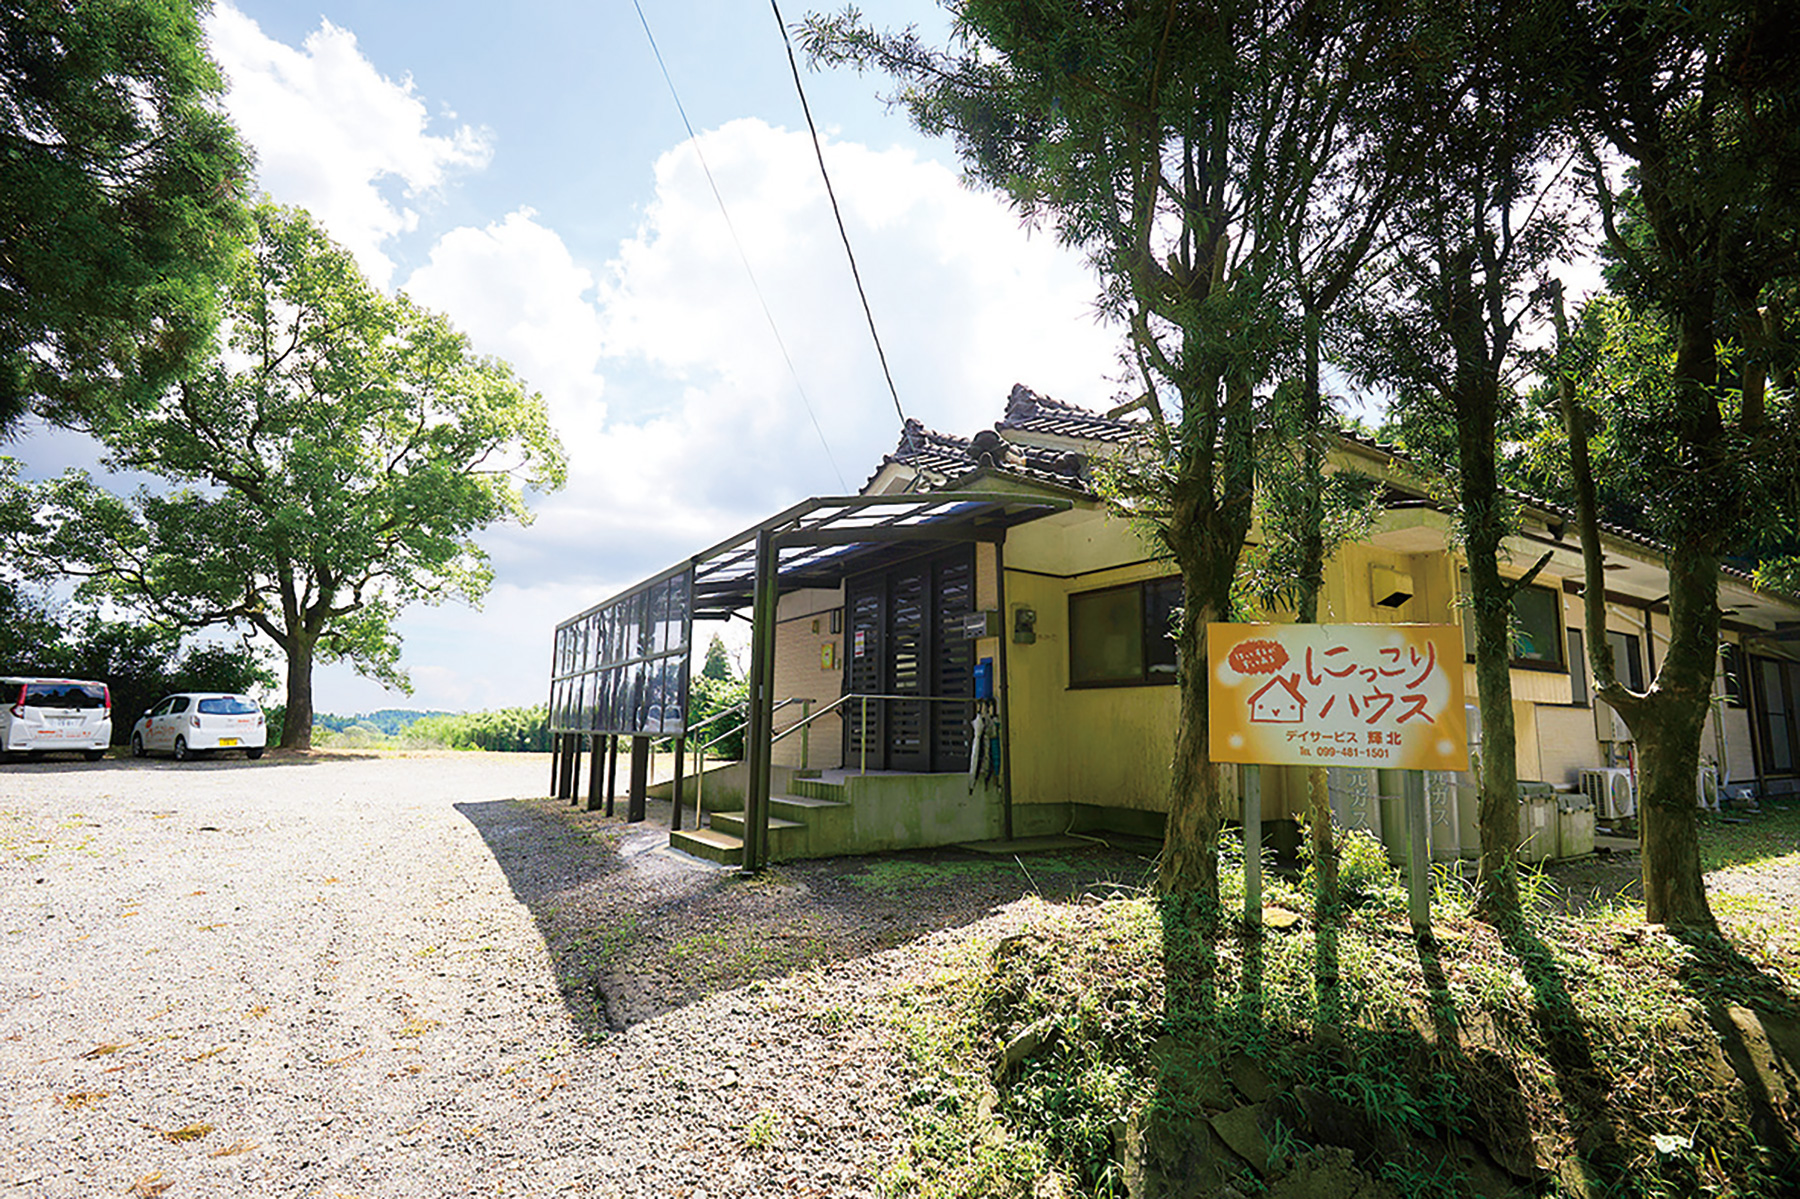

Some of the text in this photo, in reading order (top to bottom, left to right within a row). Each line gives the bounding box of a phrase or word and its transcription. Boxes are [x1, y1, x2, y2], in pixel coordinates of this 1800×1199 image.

[1306, 641, 1435, 689] にっこり
[1318, 686, 1435, 724] ハウス
[1285, 730, 1358, 743] デイサービス
[1316, 746, 1390, 758] 099-481-1501
